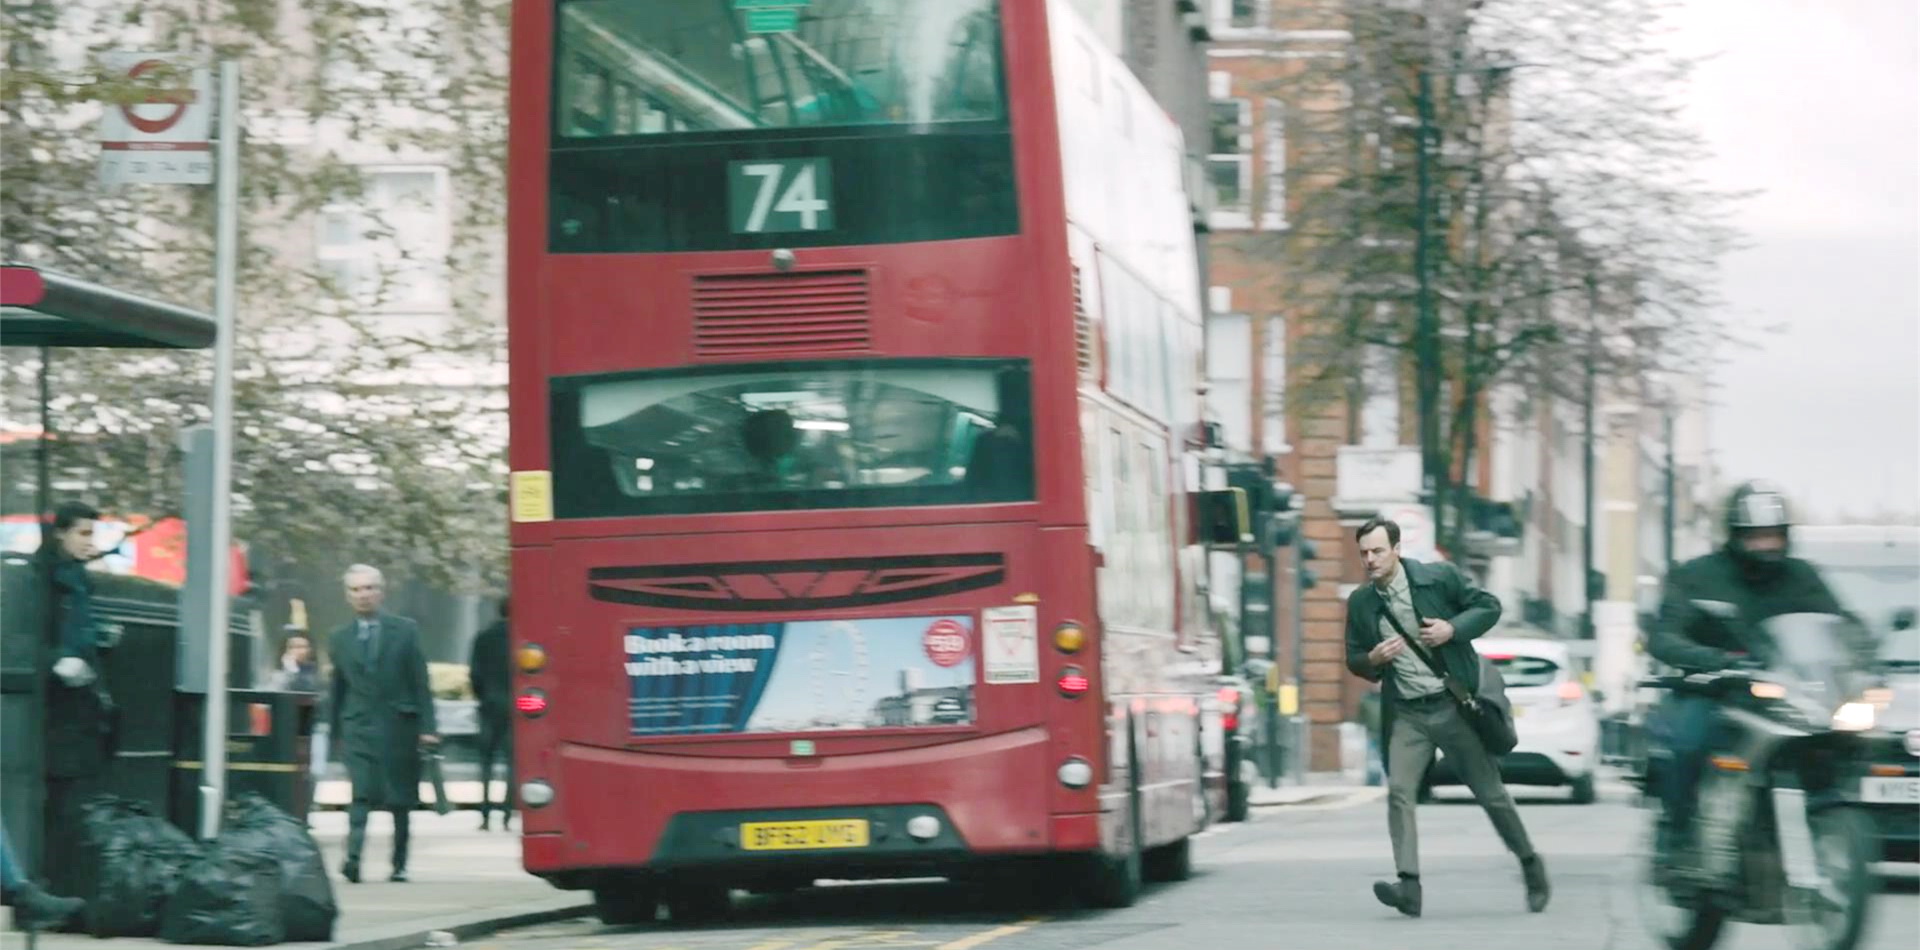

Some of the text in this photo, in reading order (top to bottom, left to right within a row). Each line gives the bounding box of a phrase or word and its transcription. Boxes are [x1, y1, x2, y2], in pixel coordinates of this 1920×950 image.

[741, 163, 829, 232] 74
[623, 632, 682, 654] Book
[705, 634, 776, 651] room
[623, 656, 680, 677] with
[699, 653, 758, 674] view
